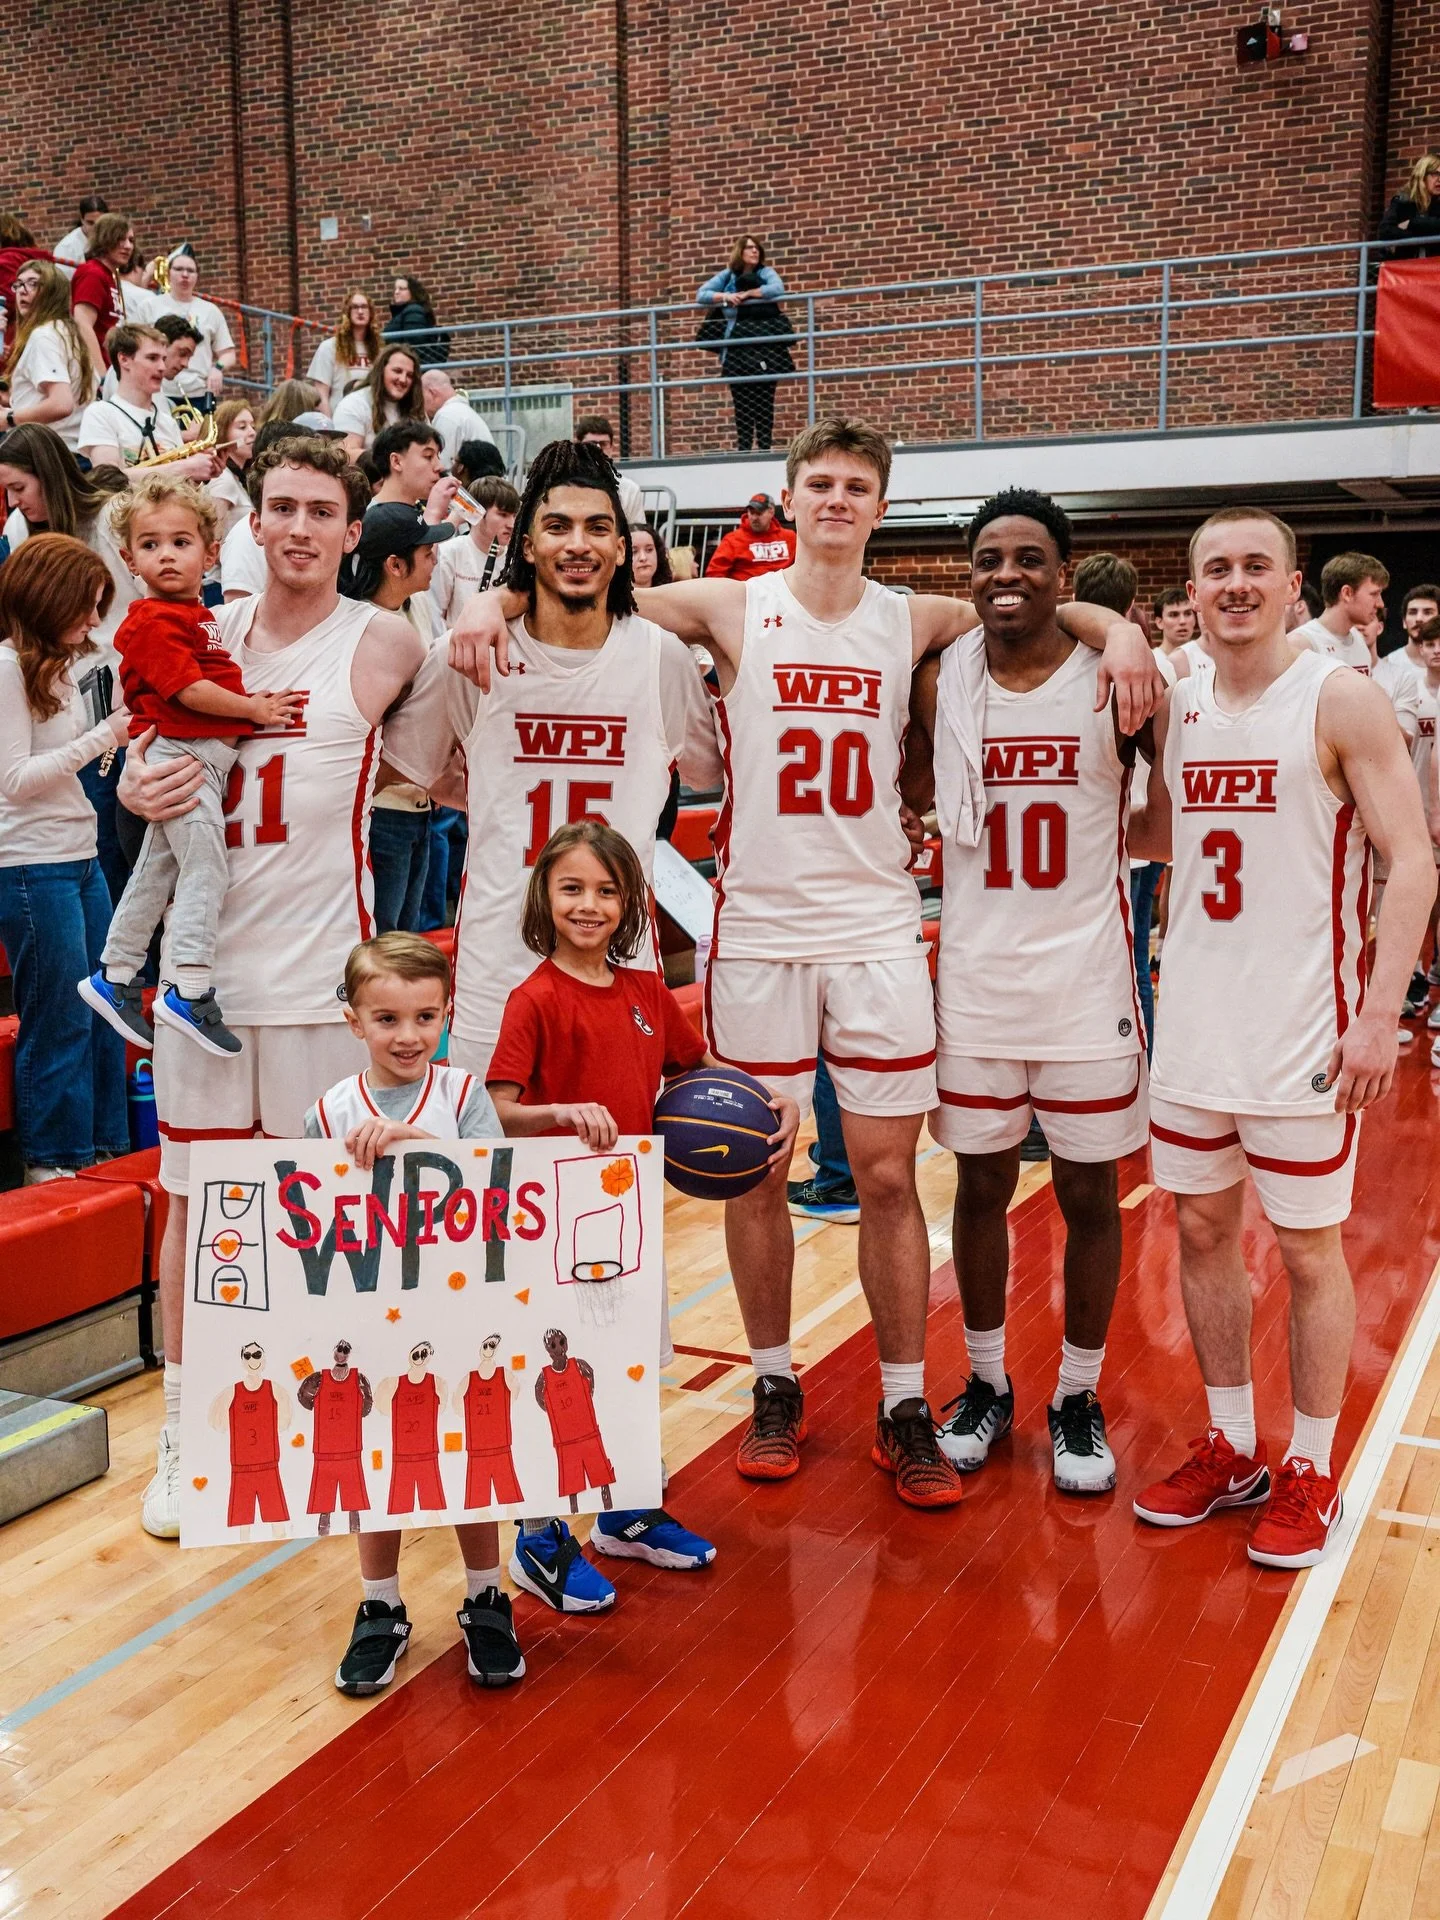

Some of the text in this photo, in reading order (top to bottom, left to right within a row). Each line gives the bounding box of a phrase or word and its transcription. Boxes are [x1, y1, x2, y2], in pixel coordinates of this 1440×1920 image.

[749, 541, 789, 561] WPI
[773, 671, 882, 711] WPI
[515, 720, 627, 758] WPI
[777, 727, 876, 818] 20
[982, 744, 1080, 779] WPI
[1182, 768, 1277, 805] WPI
[983, 801, 1069, 890] 10
[1200, 828, 1244, 923] 3
[274, 1147, 514, 1296] WPI
[243, 1403, 258, 1411] WPI
[328, 1407, 342, 1420] 15
[477, 1403, 492, 1416] 21
[560, 1397, 573, 1410] 10
[248, 1428, 258, 1446] 3
[623, 1520, 649, 1539] NIKE
[392, 1622, 409, 1636] NIKE
